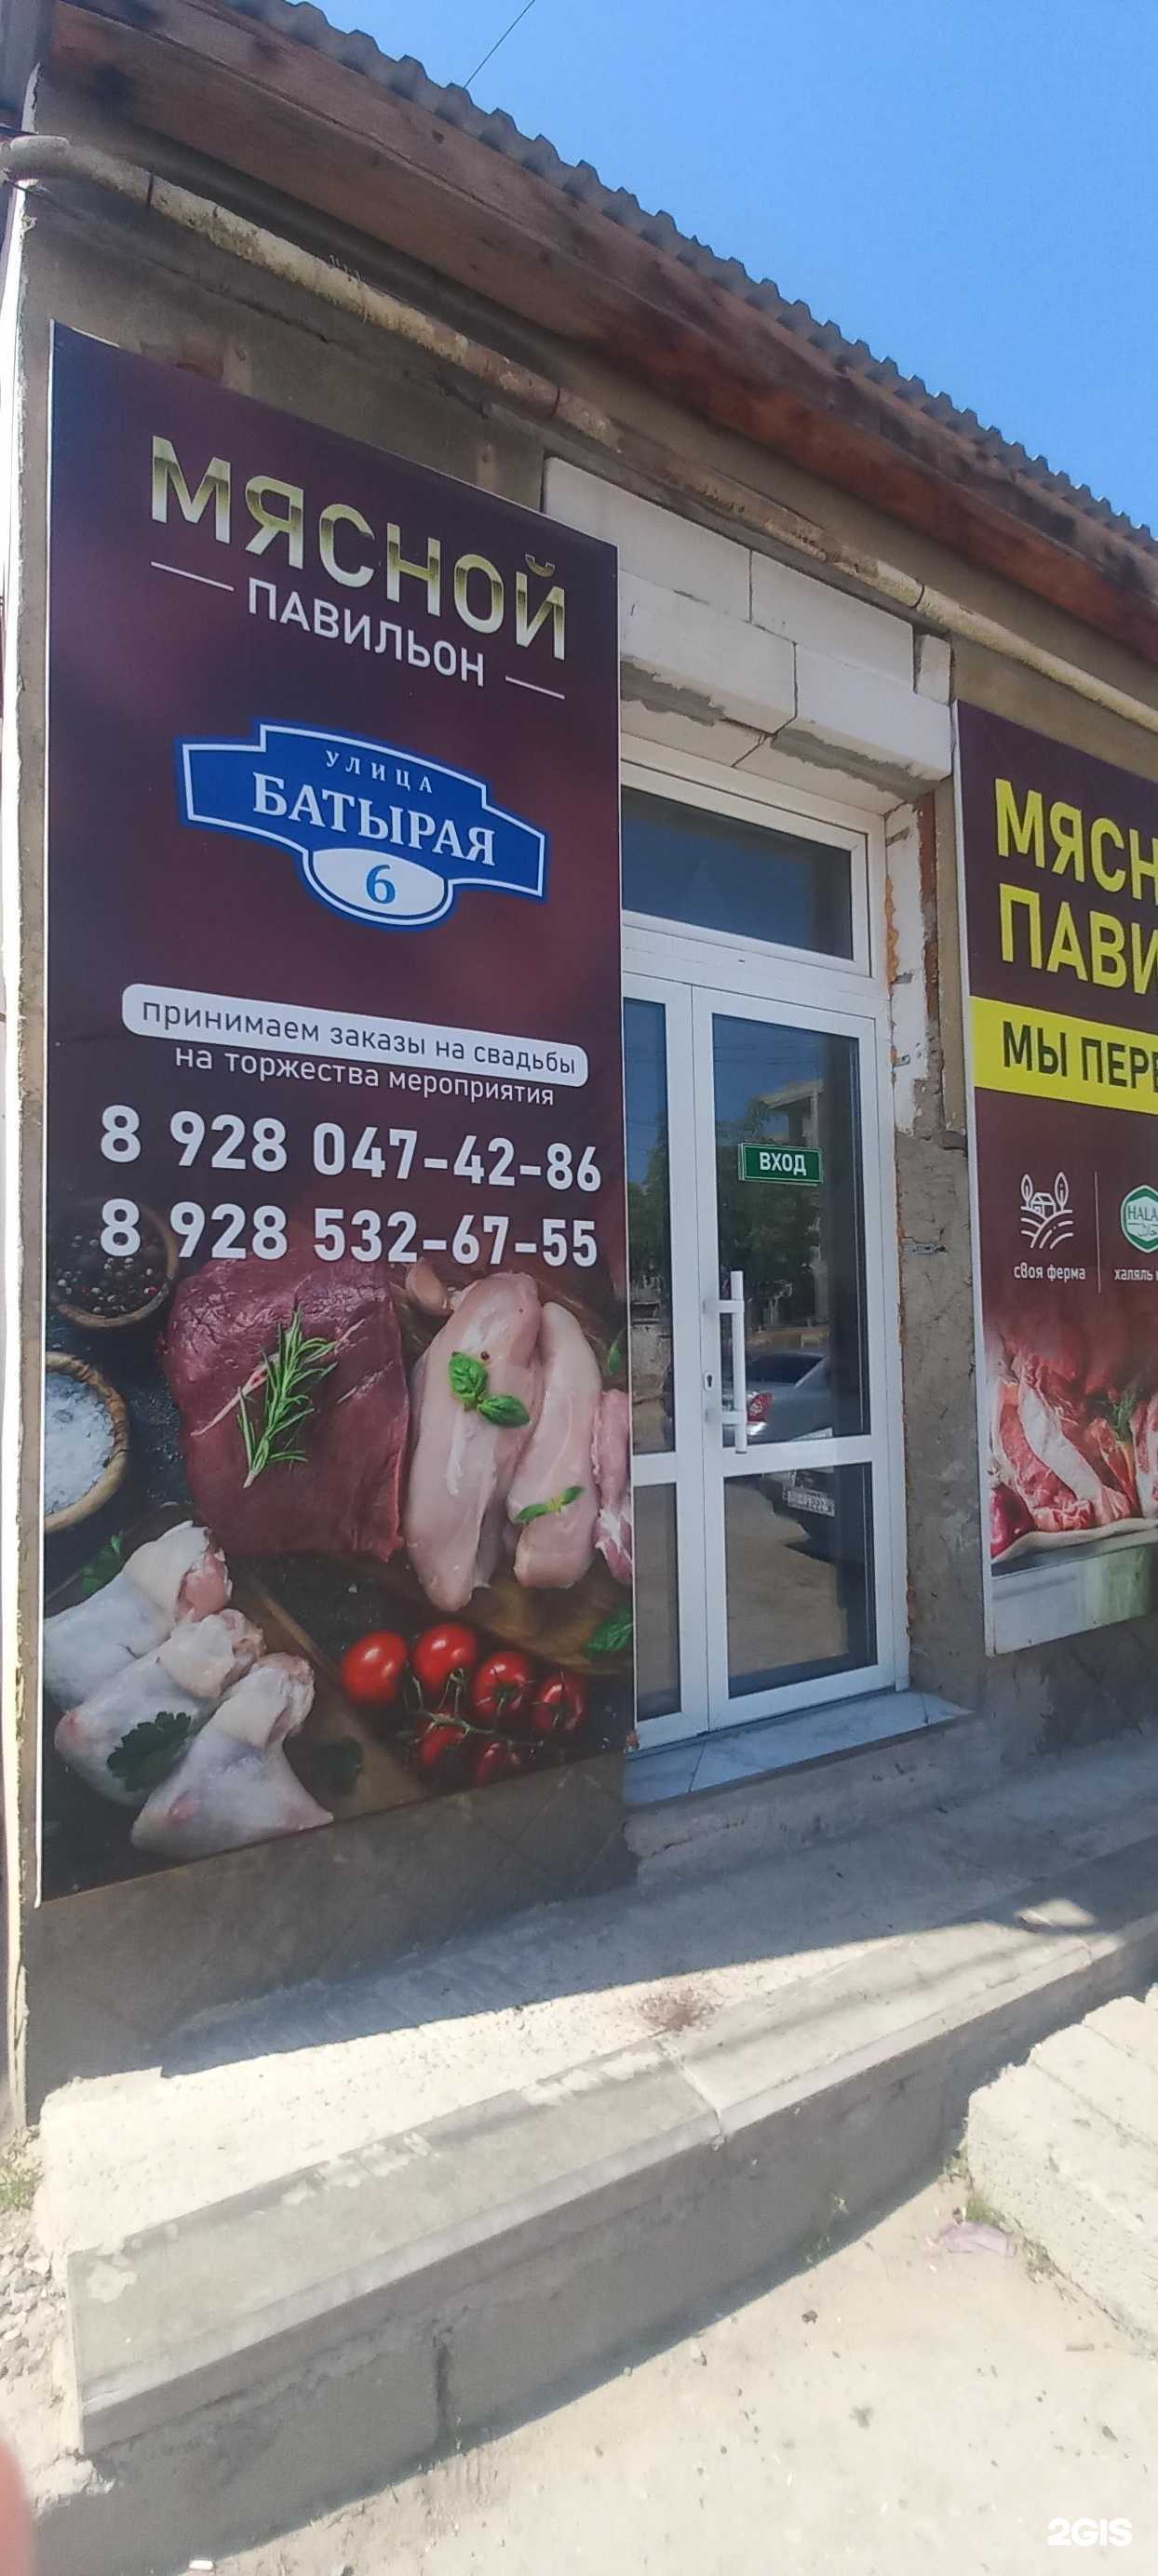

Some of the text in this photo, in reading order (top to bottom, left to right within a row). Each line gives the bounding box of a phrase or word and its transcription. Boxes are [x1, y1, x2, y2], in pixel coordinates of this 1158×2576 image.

[151, 435, 565, 661] МЯСНОЙ
[248, 577, 484, 687] ПАВИЛЬОН
[326, 749, 433, 794] УЛИЦА
[253, 771, 496, 866] БАТЫРАЯ
[994, 777, 1158, 906] МЯСН
[365, 864, 396, 905] 6
[999, 882, 1158, 996] ПАВИ
[141, 1000, 575, 1076] принимаем заказы на свадьбы
[1003, 1020, 1068, 1078] МЫ
[175, 1047, 555, 1107] на торжества мероприятия
[101, 1104, 602, 1193] 8 928 047-42-86
[759, 1151, 807, 1176] ВХОД
[101, 1197, 599, 1268] 8 928 532-67-55
[1014, 1262, 1086, 1282] своя ферма
[1114, 1268, 1153, 1281] халяль
